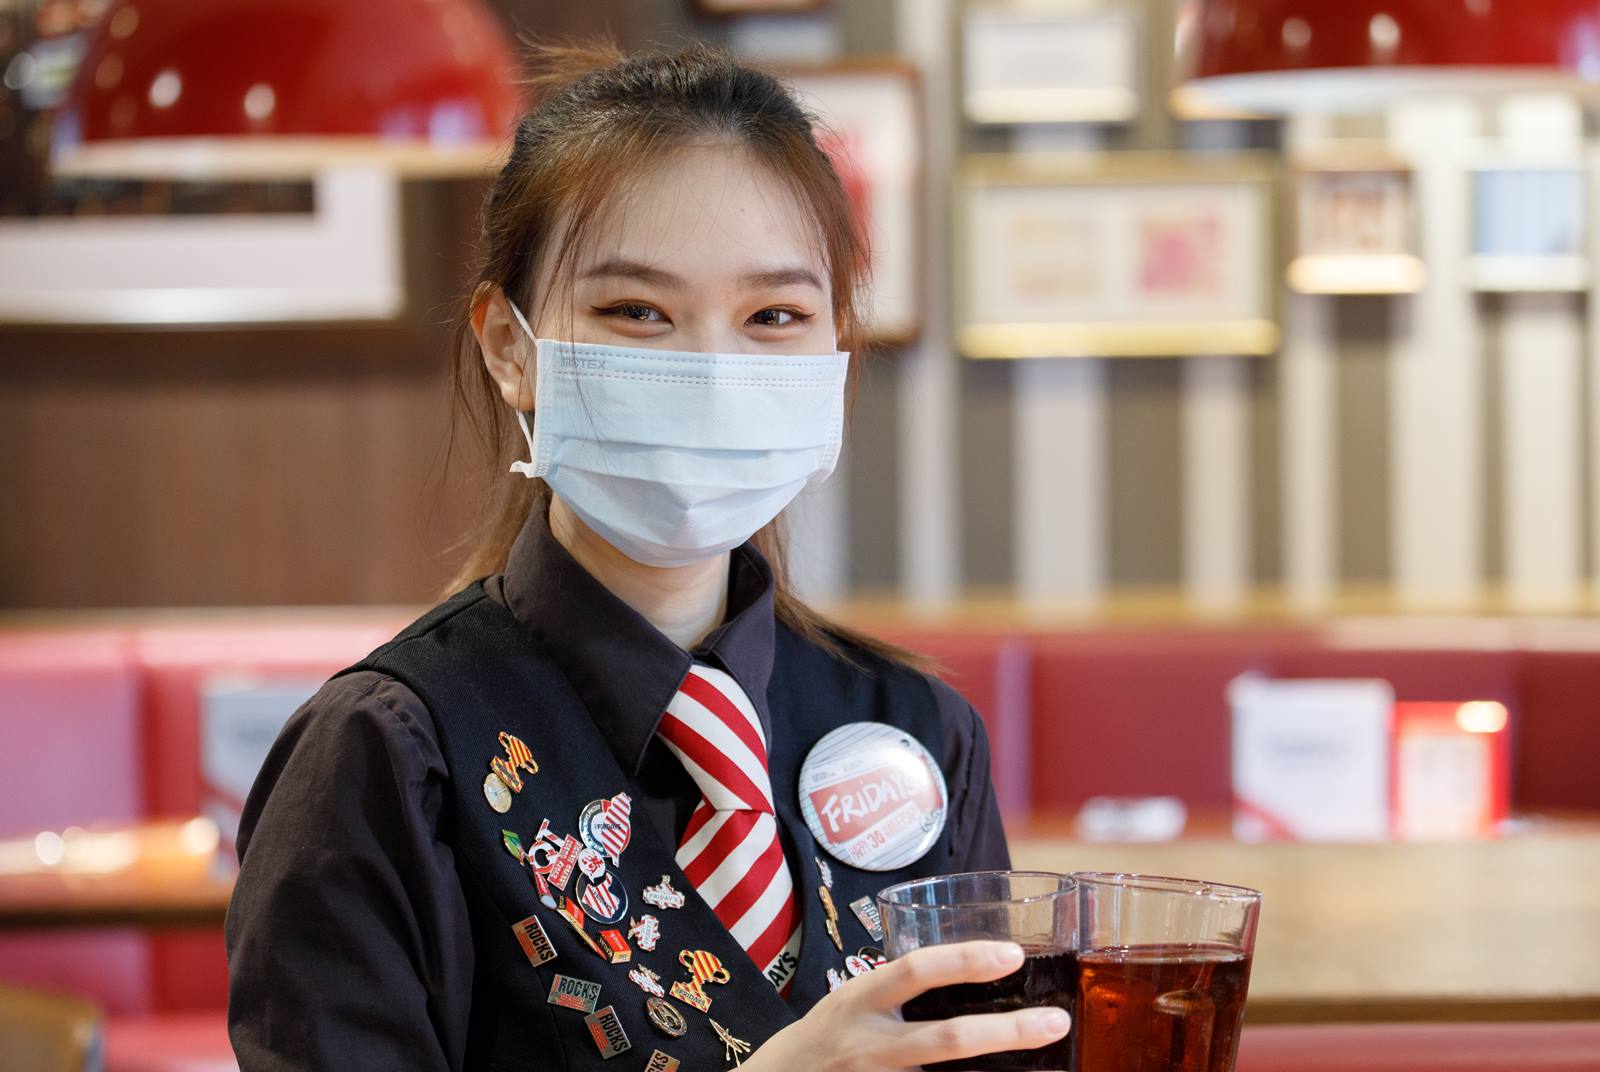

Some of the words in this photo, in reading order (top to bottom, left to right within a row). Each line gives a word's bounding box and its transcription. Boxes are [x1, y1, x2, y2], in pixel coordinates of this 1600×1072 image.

[524, 922, 554, 961] ROCKS
[558, 977, 599, 1001] ROCKS
[599, 1012, 628, 1052] ROCKS
